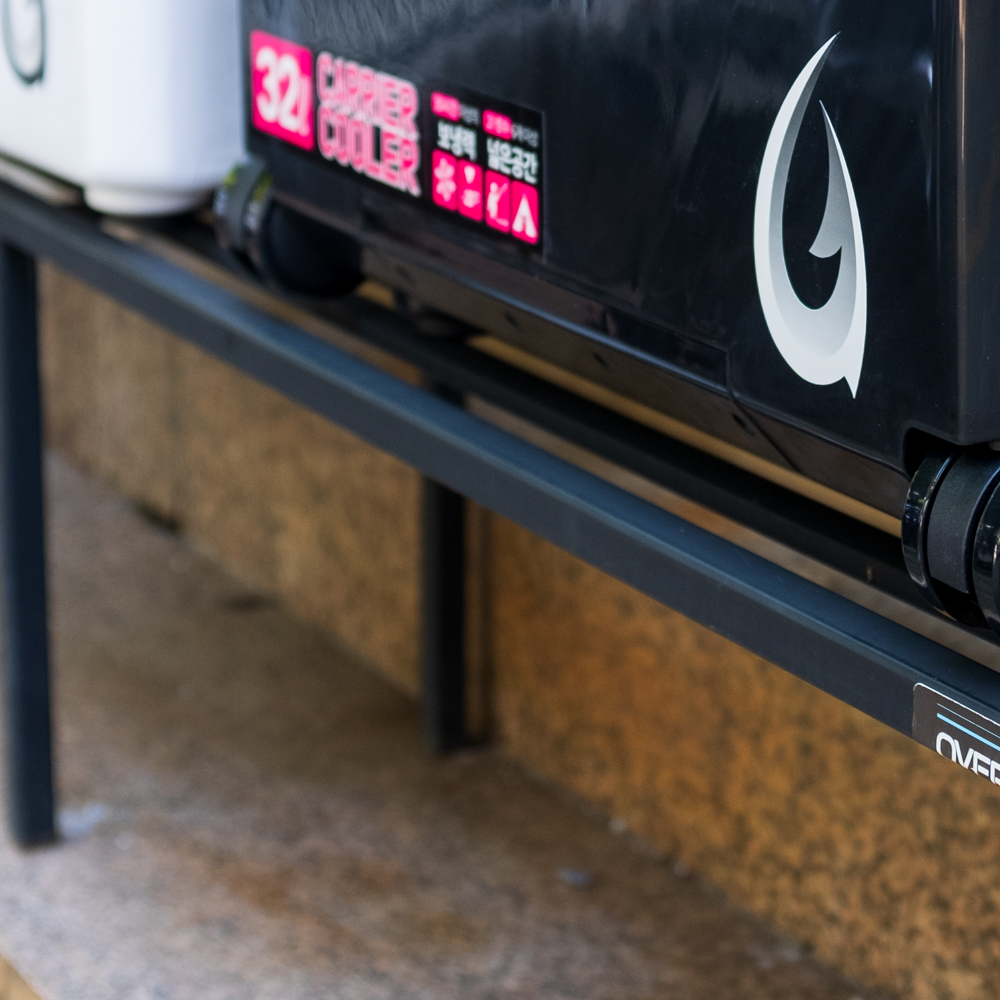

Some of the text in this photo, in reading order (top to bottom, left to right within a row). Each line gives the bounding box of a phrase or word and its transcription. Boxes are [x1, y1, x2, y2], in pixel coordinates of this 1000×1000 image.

[316, 50, 419, 143] CARRIER
[317, 104, 421, 197] COOLER
[486, 136, 540, 184] 넓은공간
